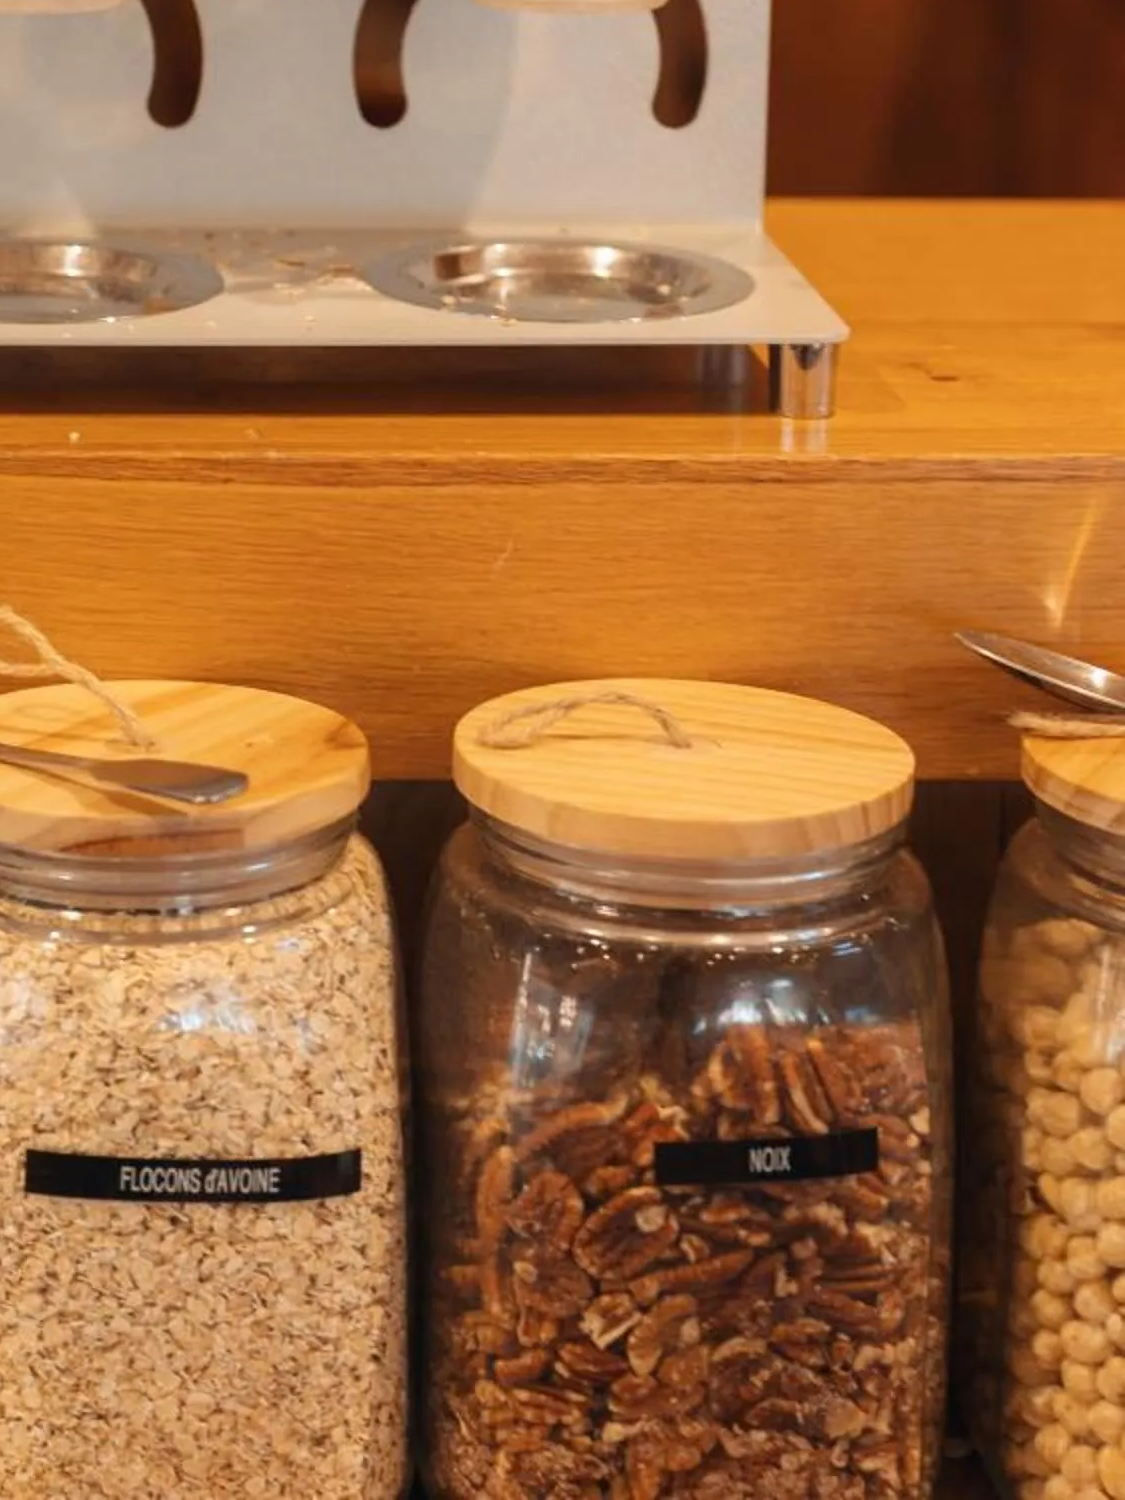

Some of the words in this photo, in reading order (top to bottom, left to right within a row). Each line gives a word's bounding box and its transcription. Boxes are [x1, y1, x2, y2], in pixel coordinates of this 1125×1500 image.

[748, 1147, 792, 1173] NOIX
[119, 1165, 201, 1193] FLOCONS
[204, 1167, 281, 1194] d'AVOINE
